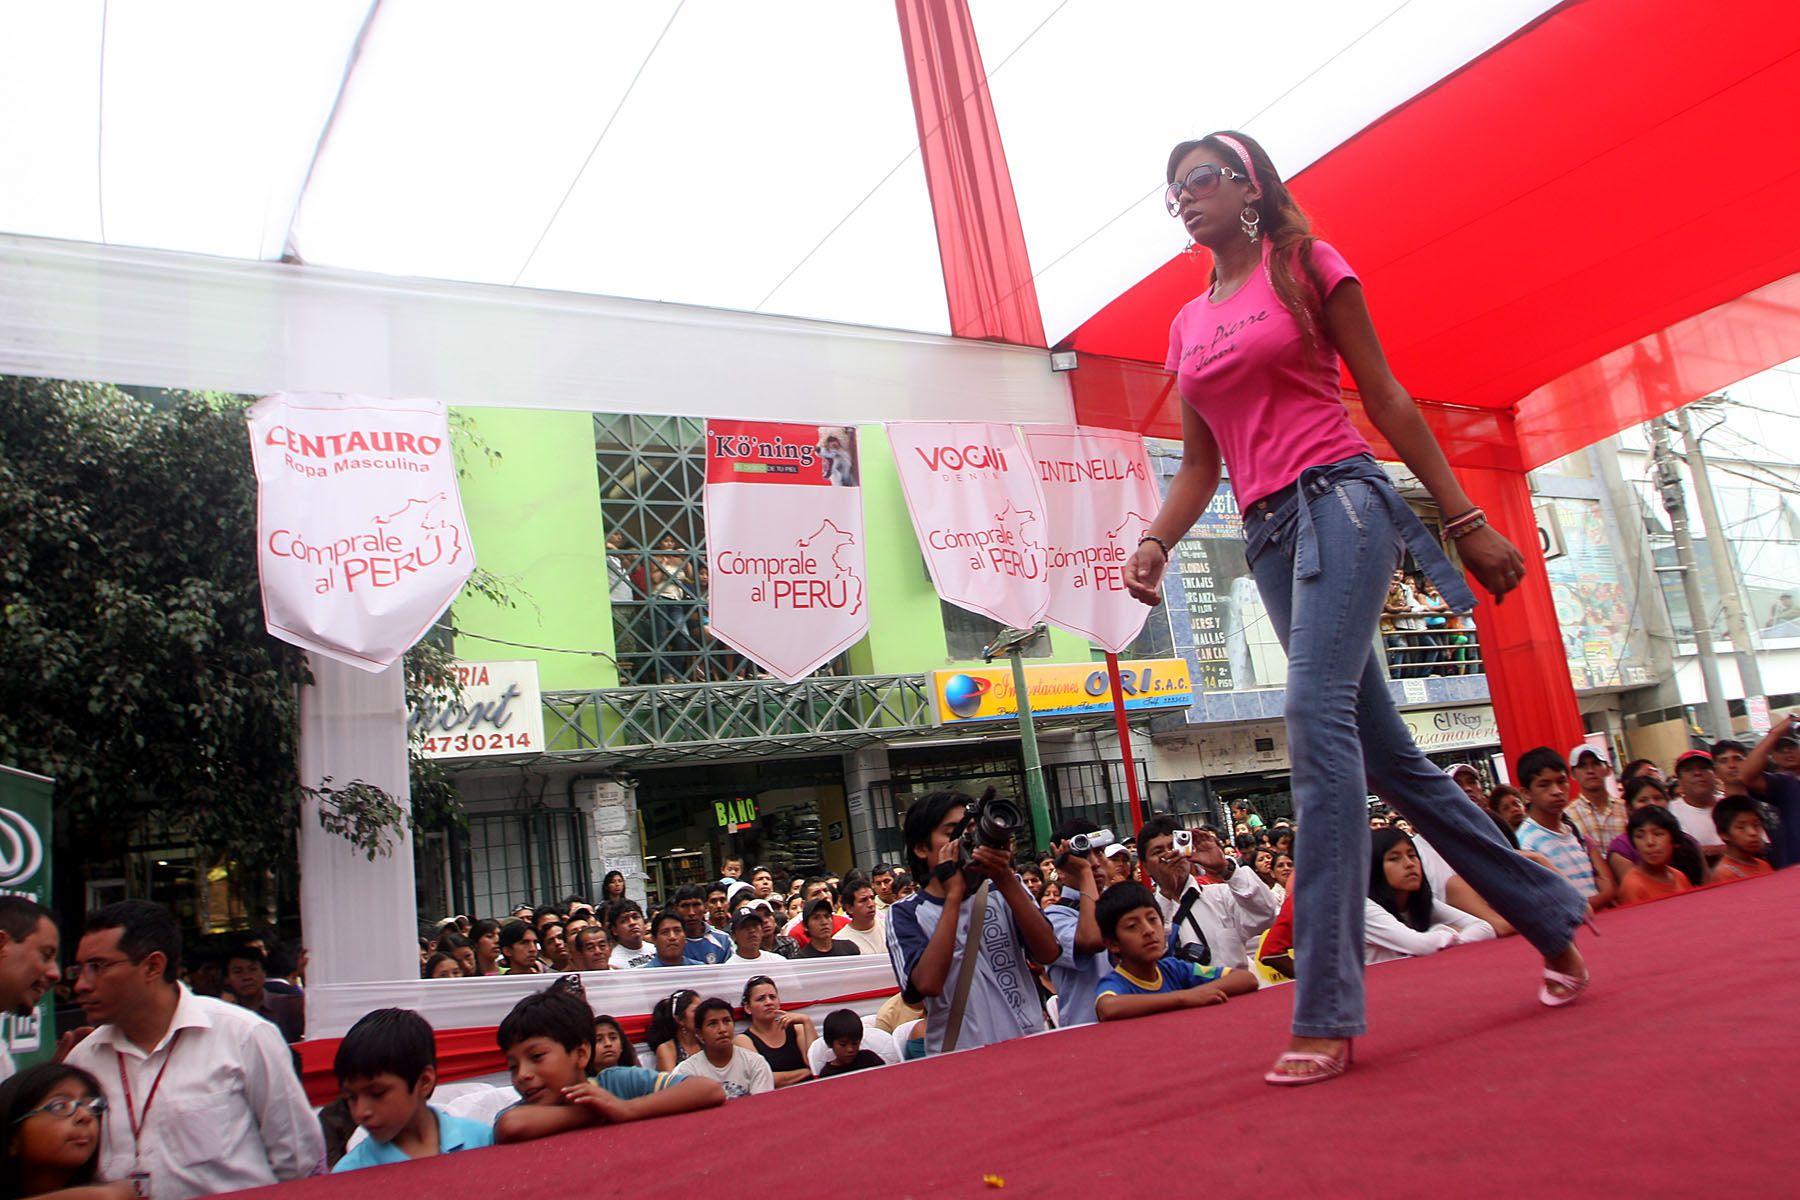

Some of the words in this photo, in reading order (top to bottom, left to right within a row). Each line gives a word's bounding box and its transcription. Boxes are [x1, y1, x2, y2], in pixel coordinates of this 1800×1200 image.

[265, 425, 442, 458] CENTAURO
[284, 453, 328, 478] Ropa
[334, 456, 430, 475] Masculina
[269, 528, 402, 565] Cómprale
[929, 524, 1014, 550] Cómprale
[315, 568, 334, 594] al
[344, 534, 442, 592] PERÚ
[717, 551, 816, 581] Cómprale
[969, 552, 985, 570] al
[989, 547, 1038, 580] PERÚ
[751, 580, 765, 602] al
[773, 573, 847, 608] PERÚ
[1074, 568, 1088, 588] al
[1094, 565, 1127, 591] PE
[1182, 577, 1214, 589] ENCAJES
[1191, 617, 1220, 630] JERSEY
[1193, 632, 1226, 645] MALLAS
[1084, 668, 1152, 697] ORI
[1434, 711, 1451, 731] El
[1453, 712, 1482, 729] King
[423, 733, 530, 753] 4730214
[982, 905, 1024, 1009] adidas
